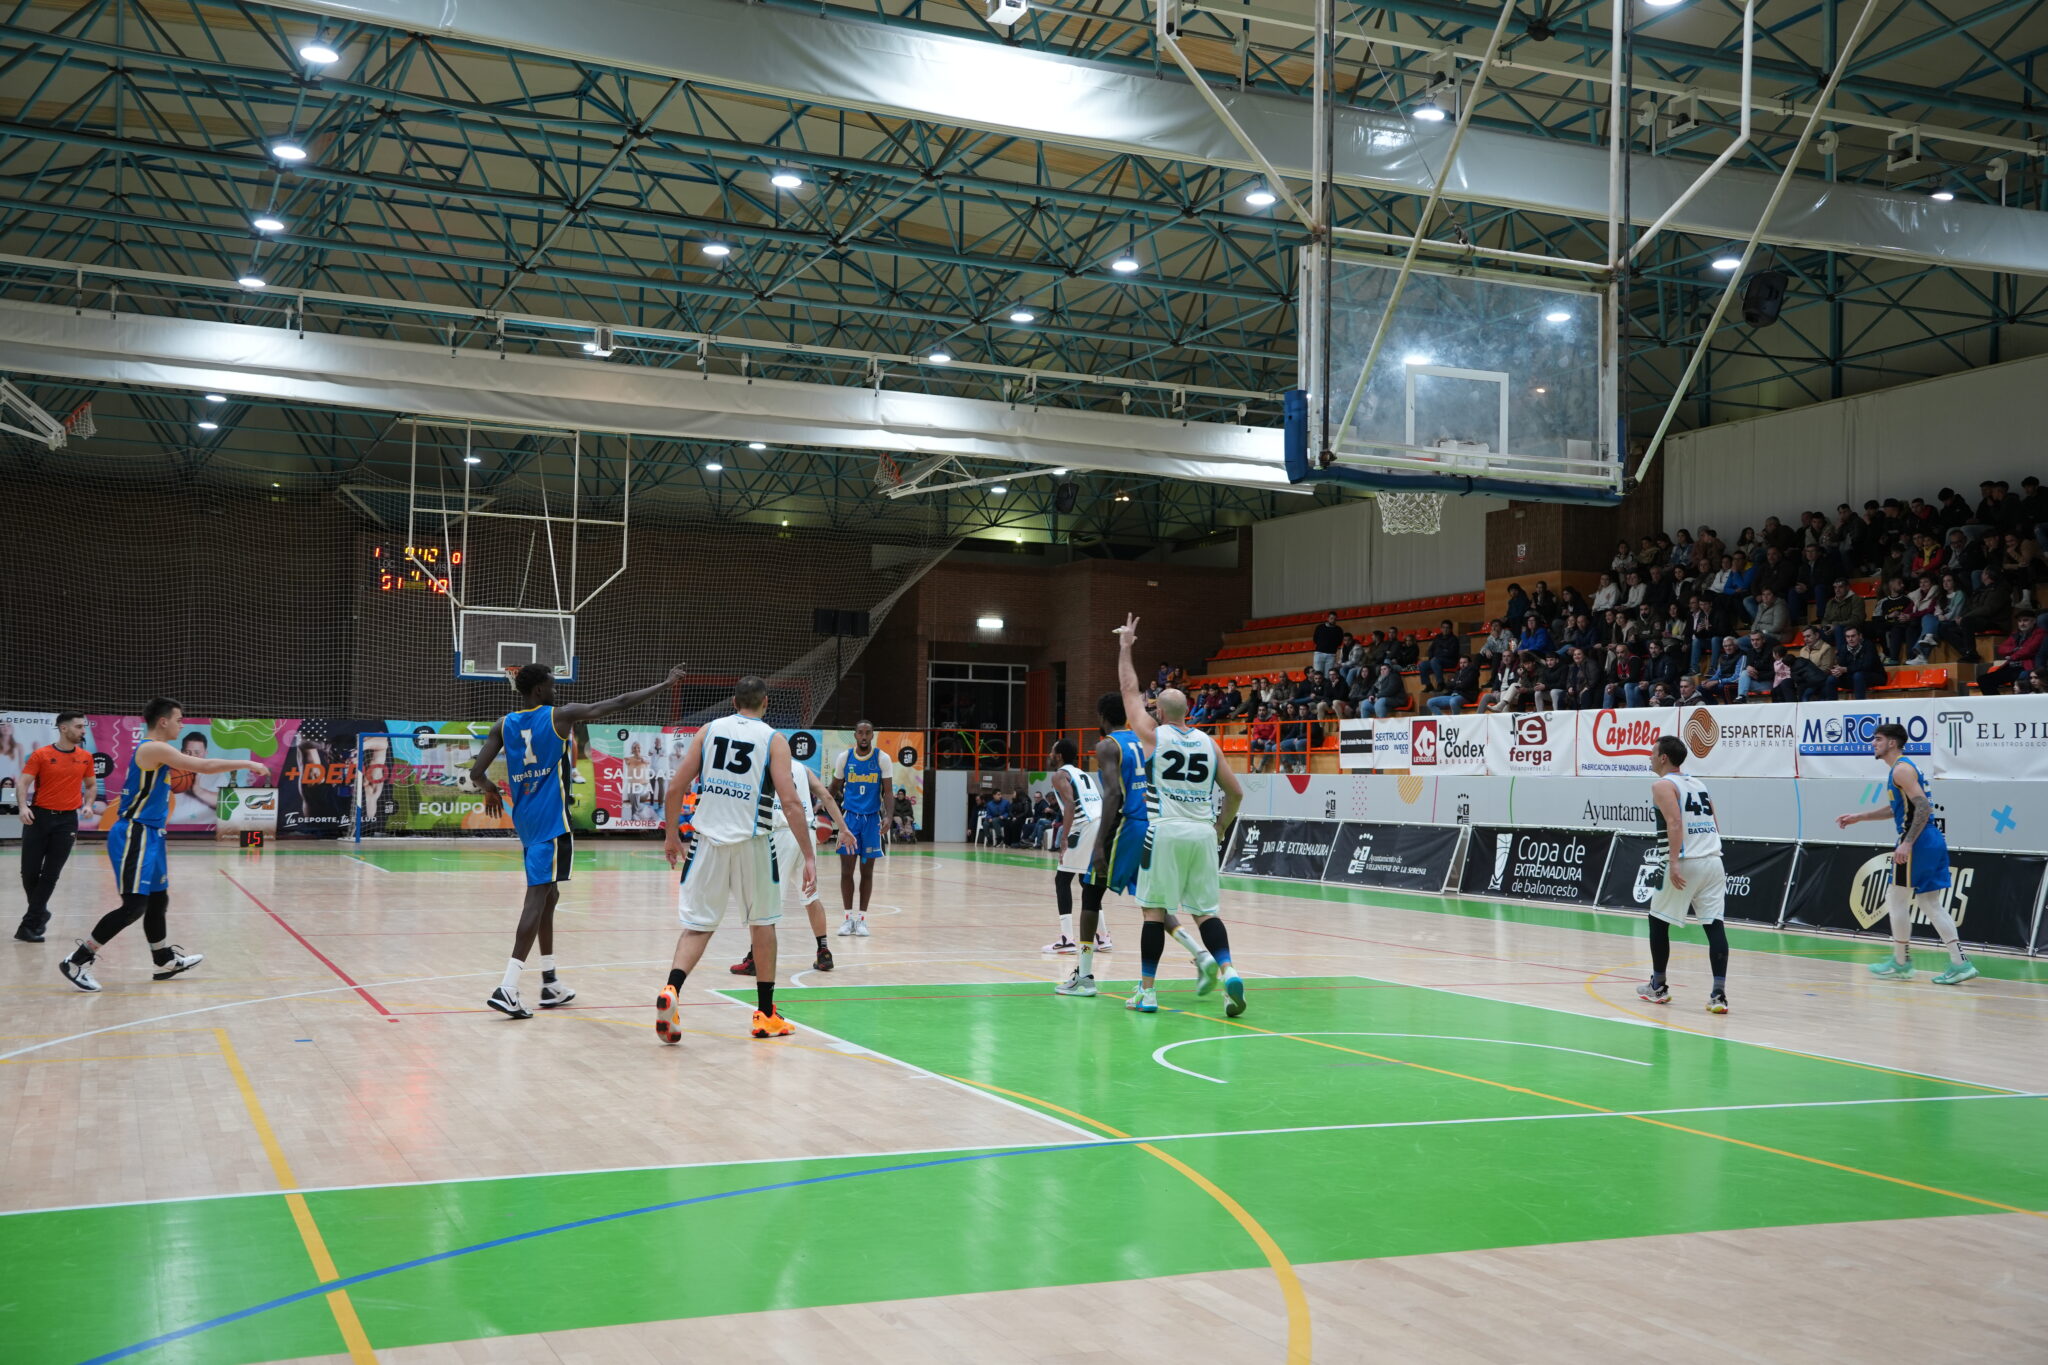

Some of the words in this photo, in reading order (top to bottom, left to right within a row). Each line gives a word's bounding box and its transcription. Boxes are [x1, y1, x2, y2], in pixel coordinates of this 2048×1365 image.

[1438, 724, 1460, 745] Ley
[1593, 708, 1661, 757] Capilla
[1802, 715, 1927, 743] MORCO
[1976, 723, 2005, 739] EL
[521, 728, 537, 766] 1
[712, 736, 755, 775] 13
[1444, 740, 1486, 758] Codex
[1800, 744, 1854, 752] COMERCIAL
[1509, 747, 1552, 766] ferga
[603, 767, 677, 780] SALUDAB
[1161, 750, 1208, 783] 25
[616, 783, 654, 794] VIDA
[707, 776, 752, 791] ALONCESTO
[418, 802, 485, 816] EQUIPO
[1582, 799, 1656, 826] Ayuntamie
[1684, 791, 1713, 816] 45
[615, 820, 657, 828] MAYORES
[1518, 835, 1560, 867] Copa
[1564, 836, 1586, 864] de
[1514, 863, 1582, 881] EXTREMADURA
[1726, 872, 1751, 884] iento
[1512, 878, 1523, 893] de
[1523, 879, 1579, 898] baloncesto
[1725, 884, 1751, 897] NITO
